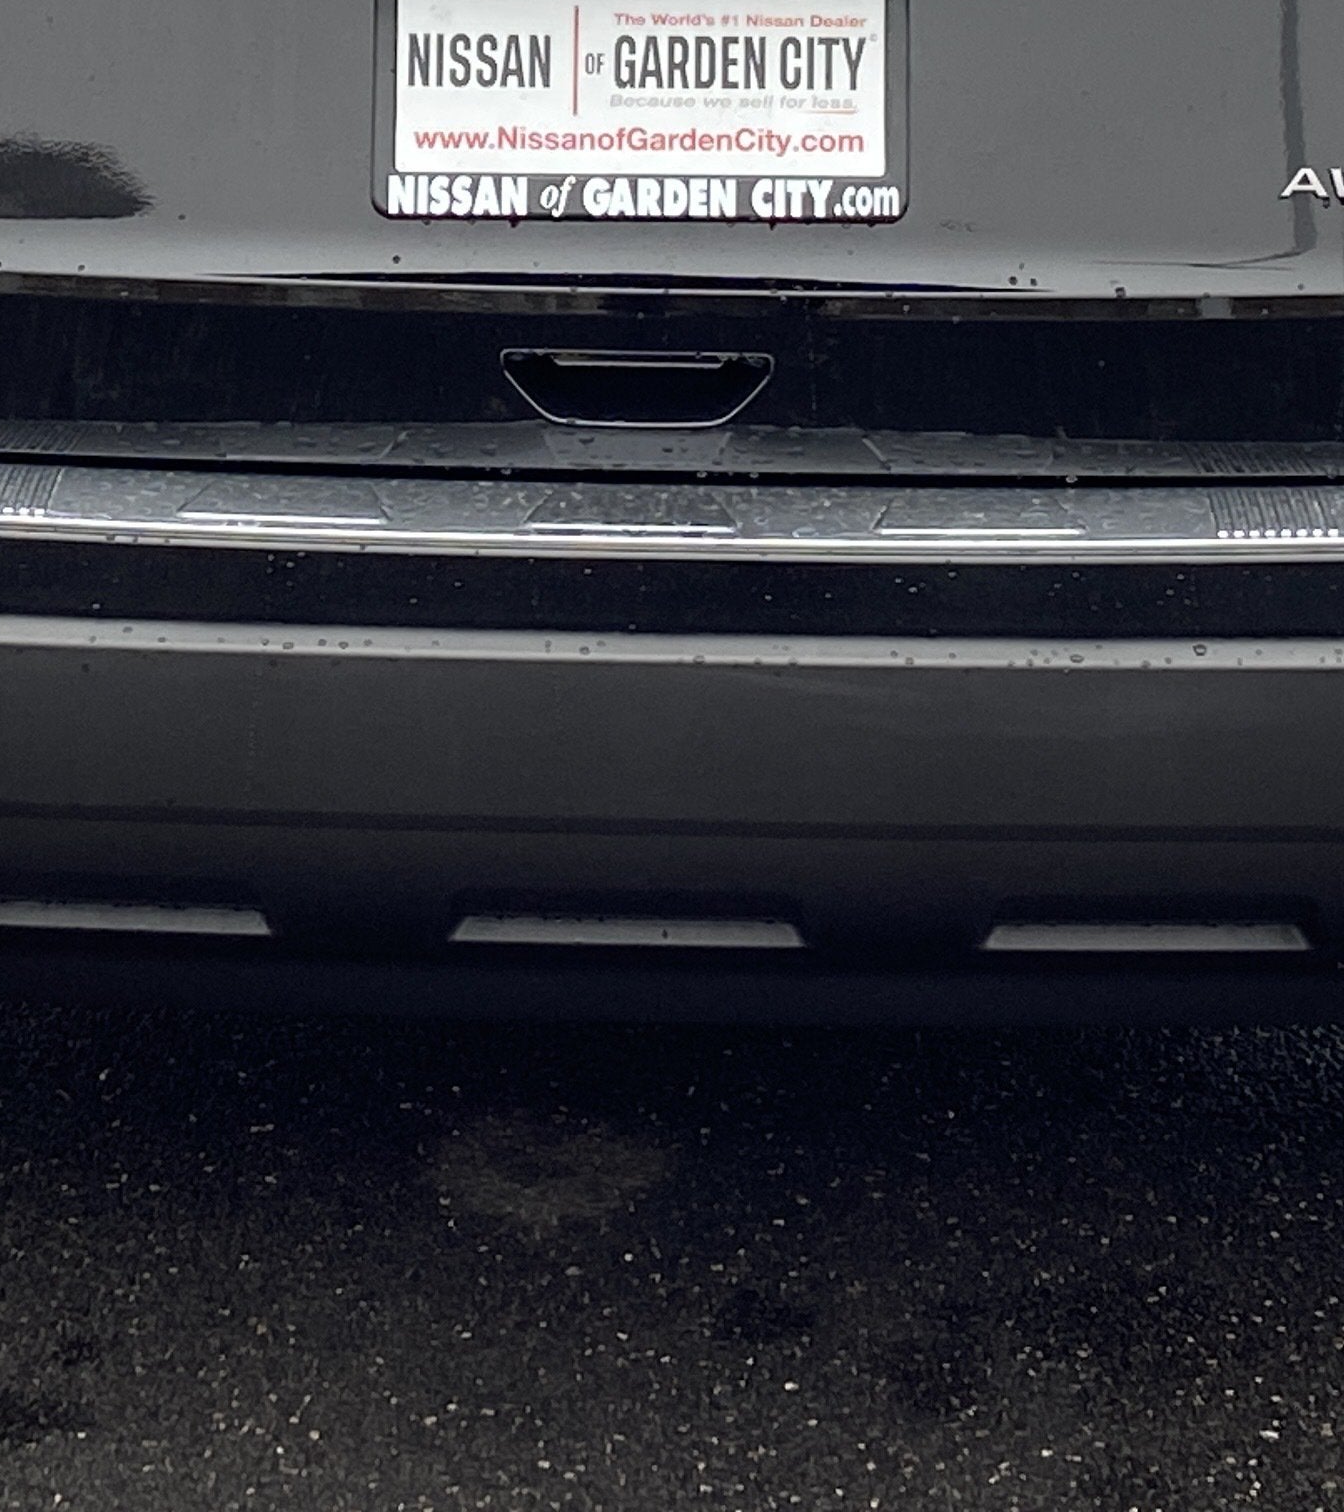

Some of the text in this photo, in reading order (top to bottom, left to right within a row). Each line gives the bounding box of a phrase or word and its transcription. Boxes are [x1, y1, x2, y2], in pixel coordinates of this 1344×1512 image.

[613, 13, 867, 28] The World's #1 Nissan Dealer
[407, 33, 866, 90] NISSAN OF GARDEN CITY
[610, 94, 696, 108] Because
[703, 96, 732, 108] we
[738, 94, 773, 109] sell
[779, 94, 807, 109] for
[415, 124, 864, 156] www.NissanofGardenCity.com
[387, 175, 900, 218] NISSAN of GARDEN CITY.com
